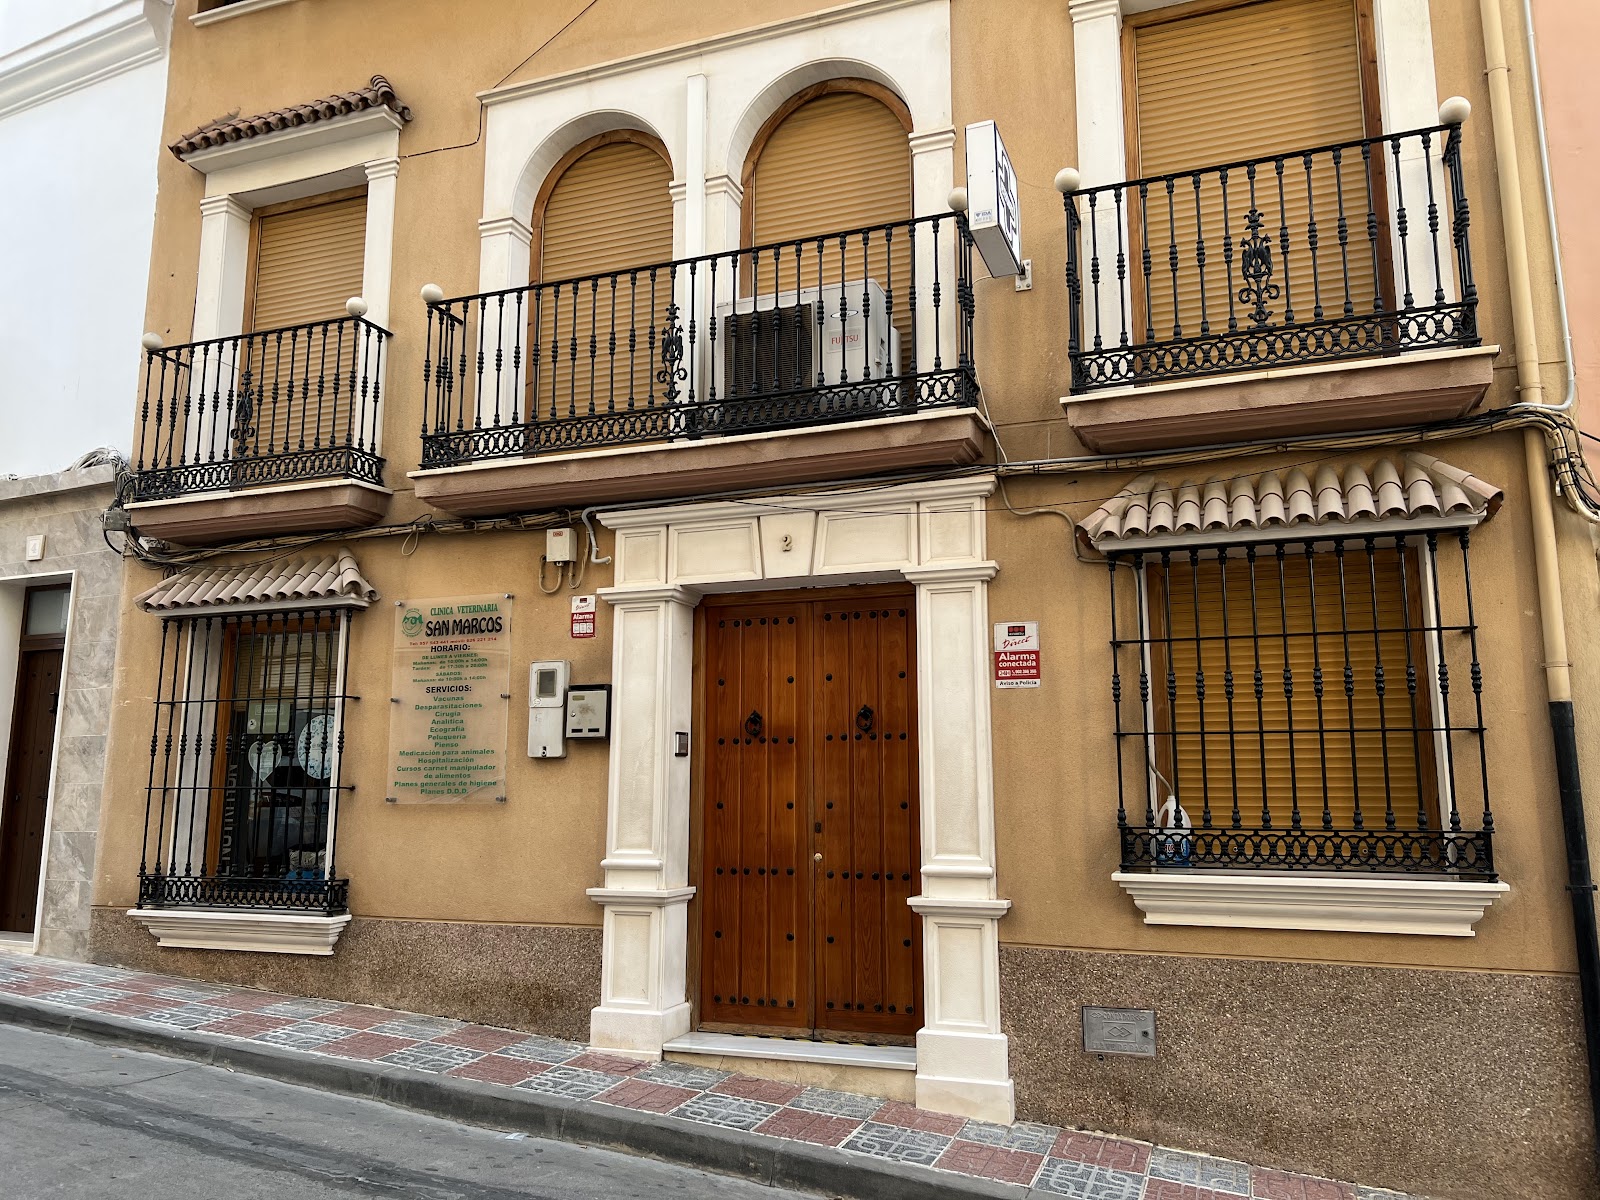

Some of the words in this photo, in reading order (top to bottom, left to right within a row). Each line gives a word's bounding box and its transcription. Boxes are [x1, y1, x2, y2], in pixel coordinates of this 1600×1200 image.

[832, 335, 858, 344] FUTSU
[31, 542, 37, 553] 4
[782, 534, 792, 552] 2
[431, 607, 454, 616] CLINICA
[457, 604, 498, 614] VETERINARIA
[425, 620, 449, 637] SAN
[452, 616, 503, 635] MARCOS
[431, 644, 470, 652] HORARIO:
[1002, 636, 1032, 649] Direct
[999, 653, 1036, 661] Alarma
[426, 685, 472, 693] SERVICIOS:
